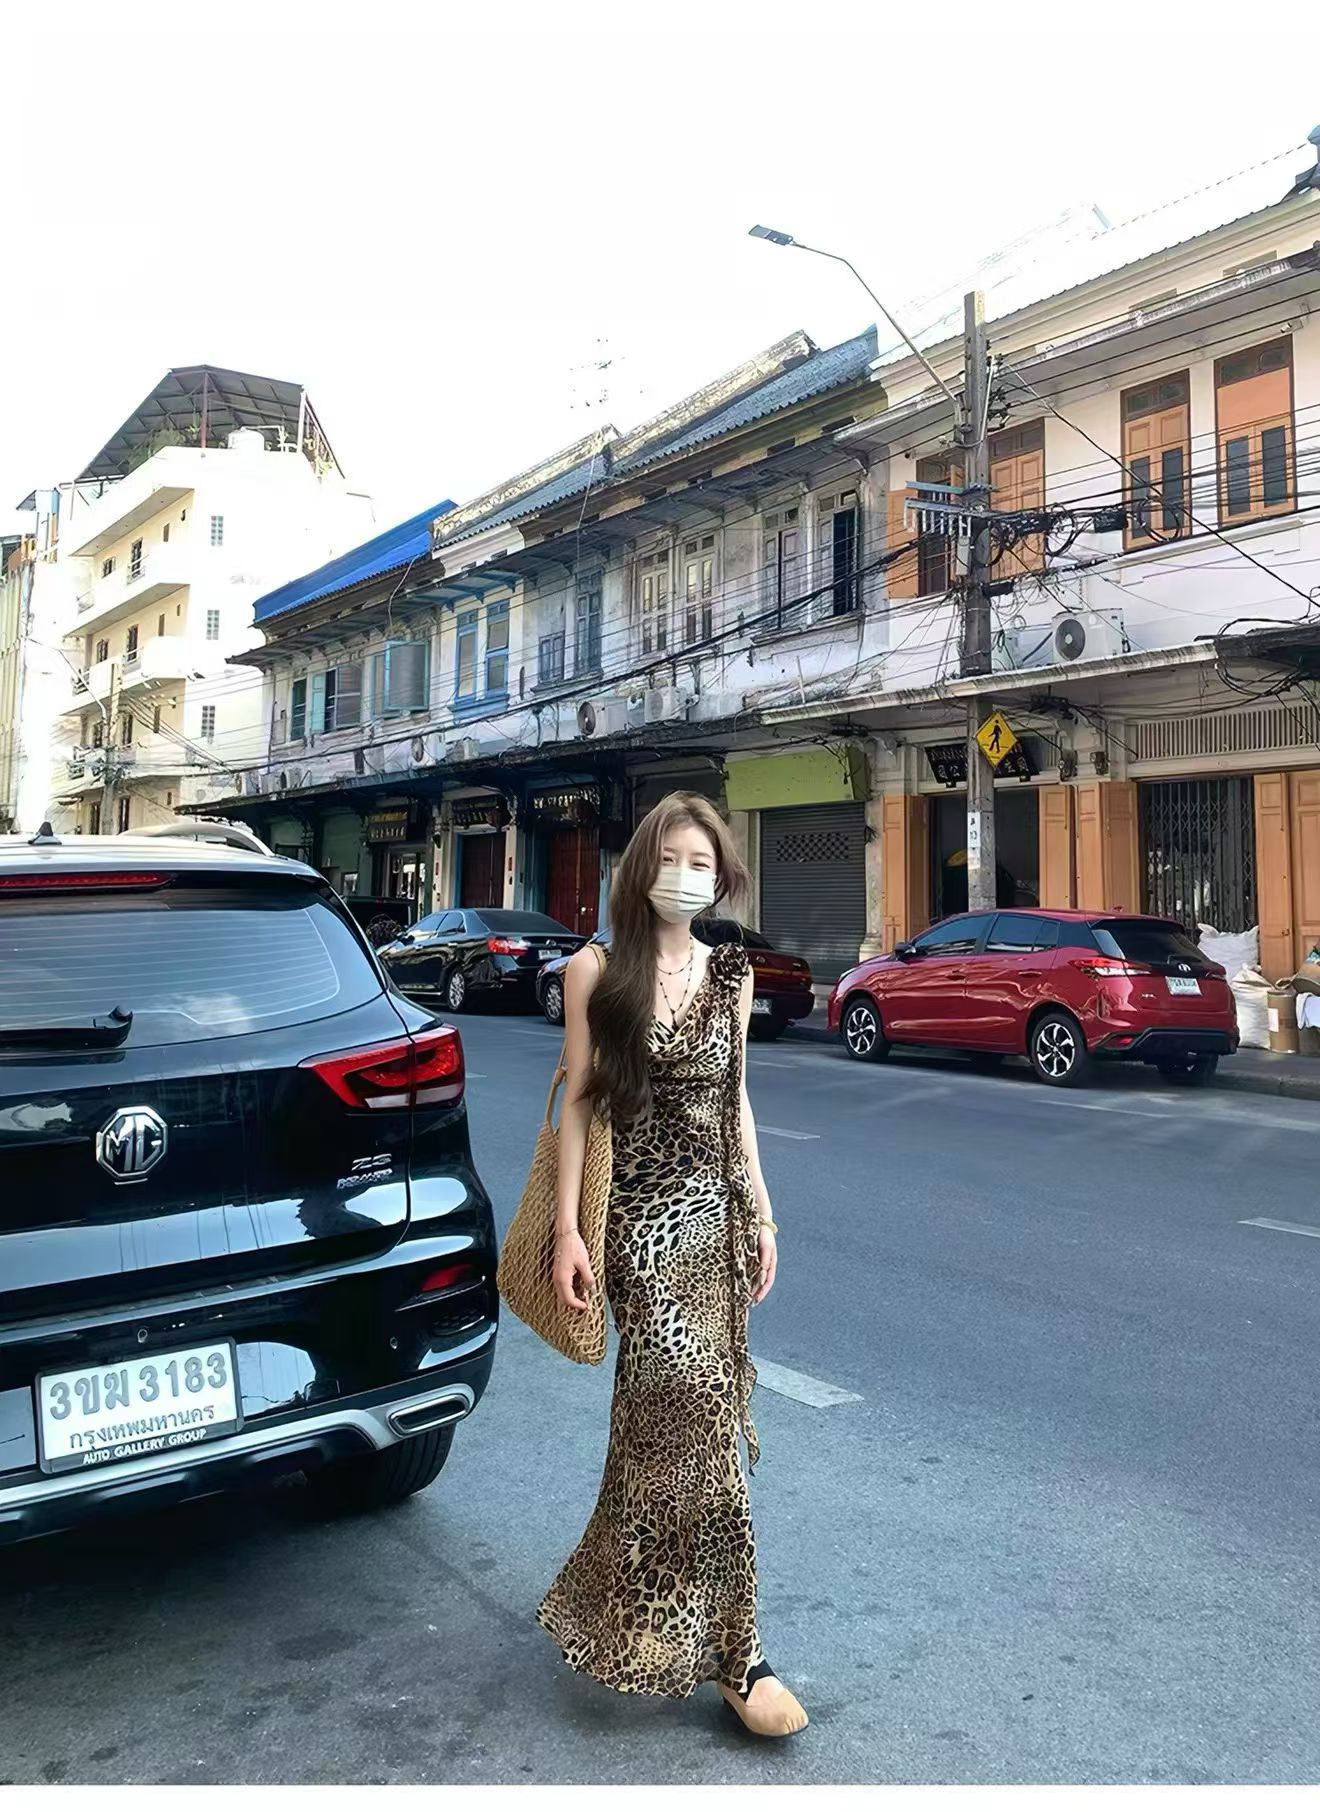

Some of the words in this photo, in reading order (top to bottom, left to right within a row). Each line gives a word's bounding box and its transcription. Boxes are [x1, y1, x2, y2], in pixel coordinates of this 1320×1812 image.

[105, 1113, 162, 1172] MG
[138, 1351, 228, 1403] 3183
[69, 1404, 215, 1450] กรุงเทพมหานคร
[83, 1448, 112, 1465] AUTO
[114, 1437, 165, 1458] GALLERY
[168, 1428, 207, 1447] GROUP
